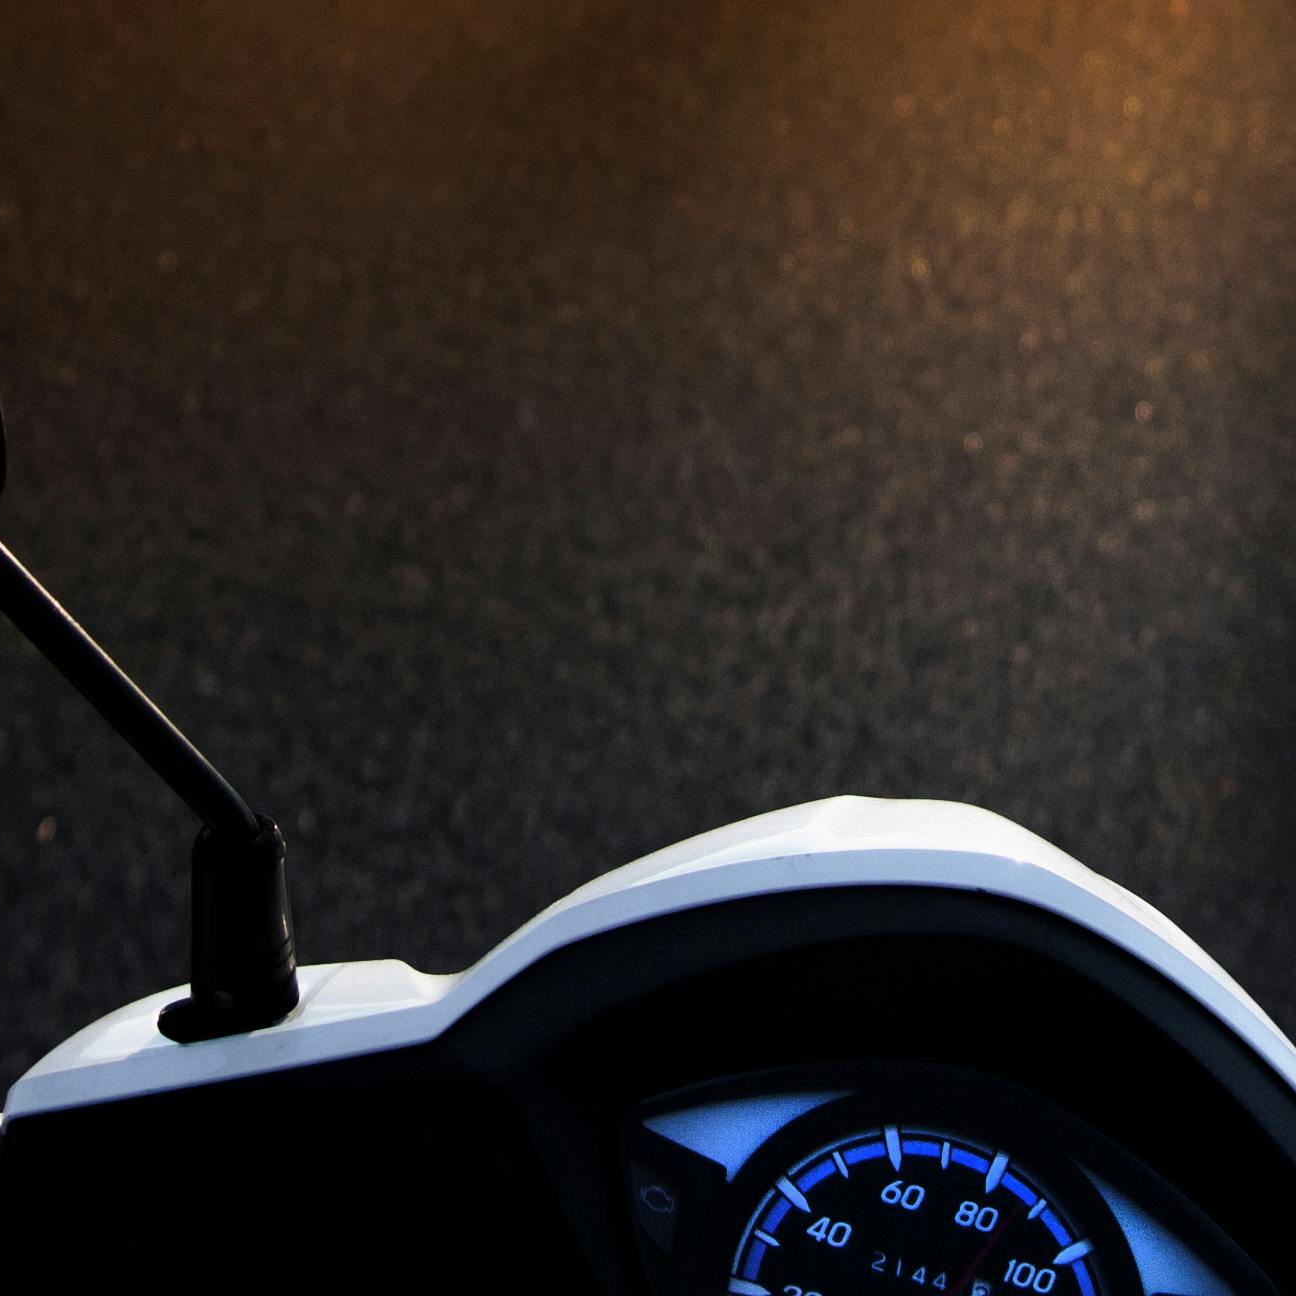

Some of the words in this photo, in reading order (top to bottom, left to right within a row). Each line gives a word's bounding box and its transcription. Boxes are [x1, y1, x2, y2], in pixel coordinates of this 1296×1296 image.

[881, 1180, 925, 1211] 60
[955, 1201, 999, 1232] 80
[806, 1217, 852, 1249] 40
[1003, 1259, 1056, 1295] 100
